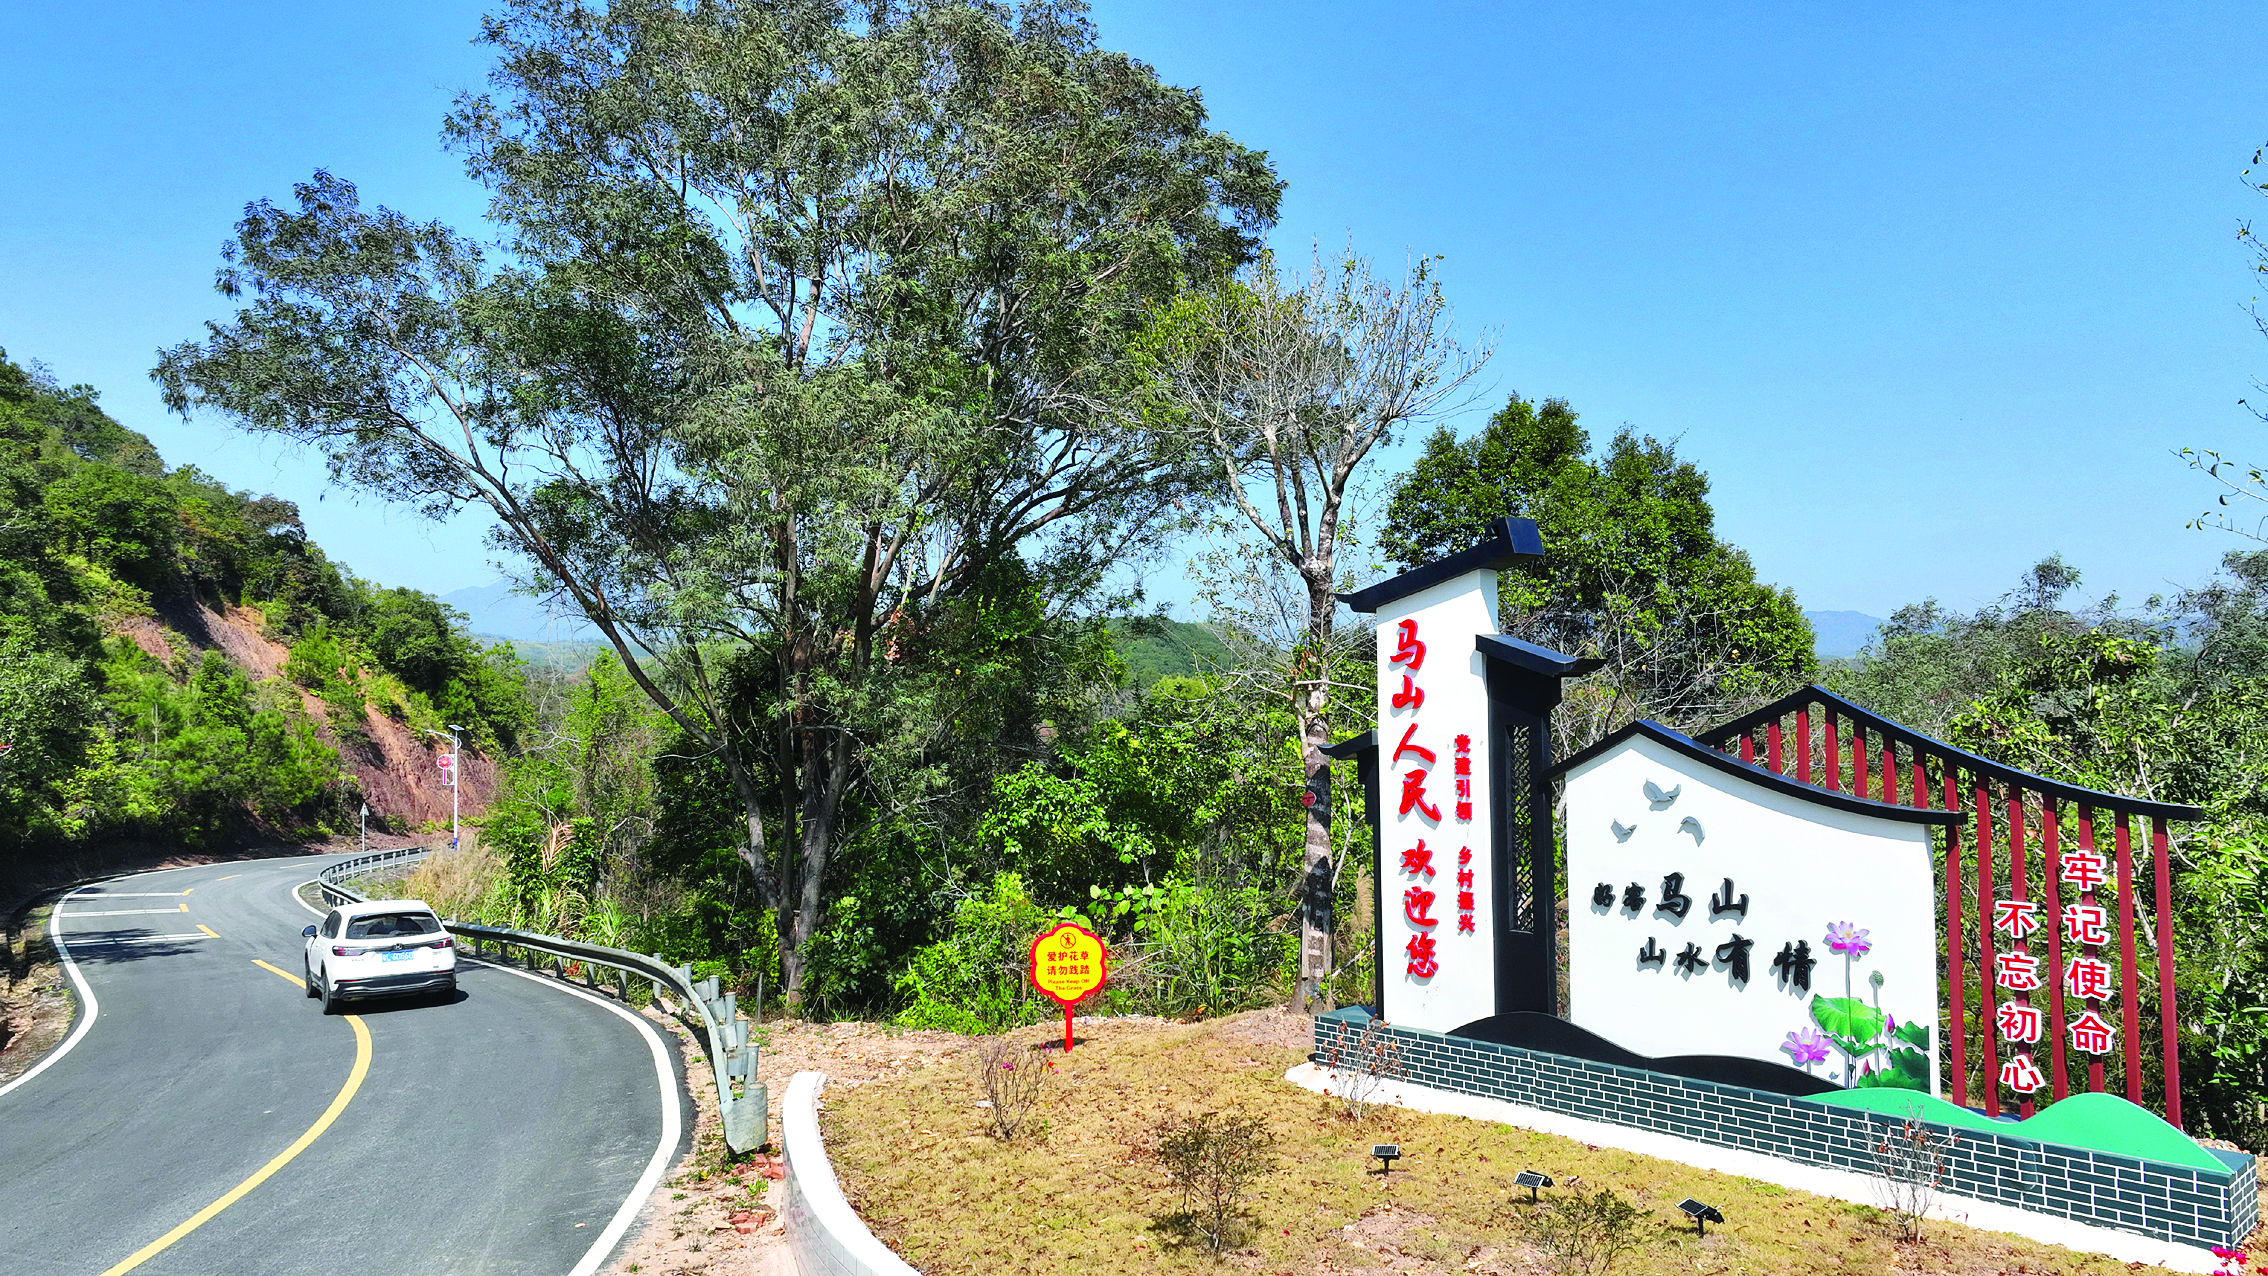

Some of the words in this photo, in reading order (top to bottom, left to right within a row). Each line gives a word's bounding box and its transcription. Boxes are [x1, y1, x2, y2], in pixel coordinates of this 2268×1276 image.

[1454, 733, 1473, 821] 党建引领
[1457, 845, 1476, 933] 乡村振兴
[1593, 871, 1750, 919] 好客马山
[1046, 950, 1090, 962] 爱护花草
[1046, 964, 1090, 976] 请勿践踏
[1639, 933, 1818, 992] 山水有情
[2062, 851, 2114, 1054] 牢记使命
[1995, 902, 2043, 1093] 不忘初心
